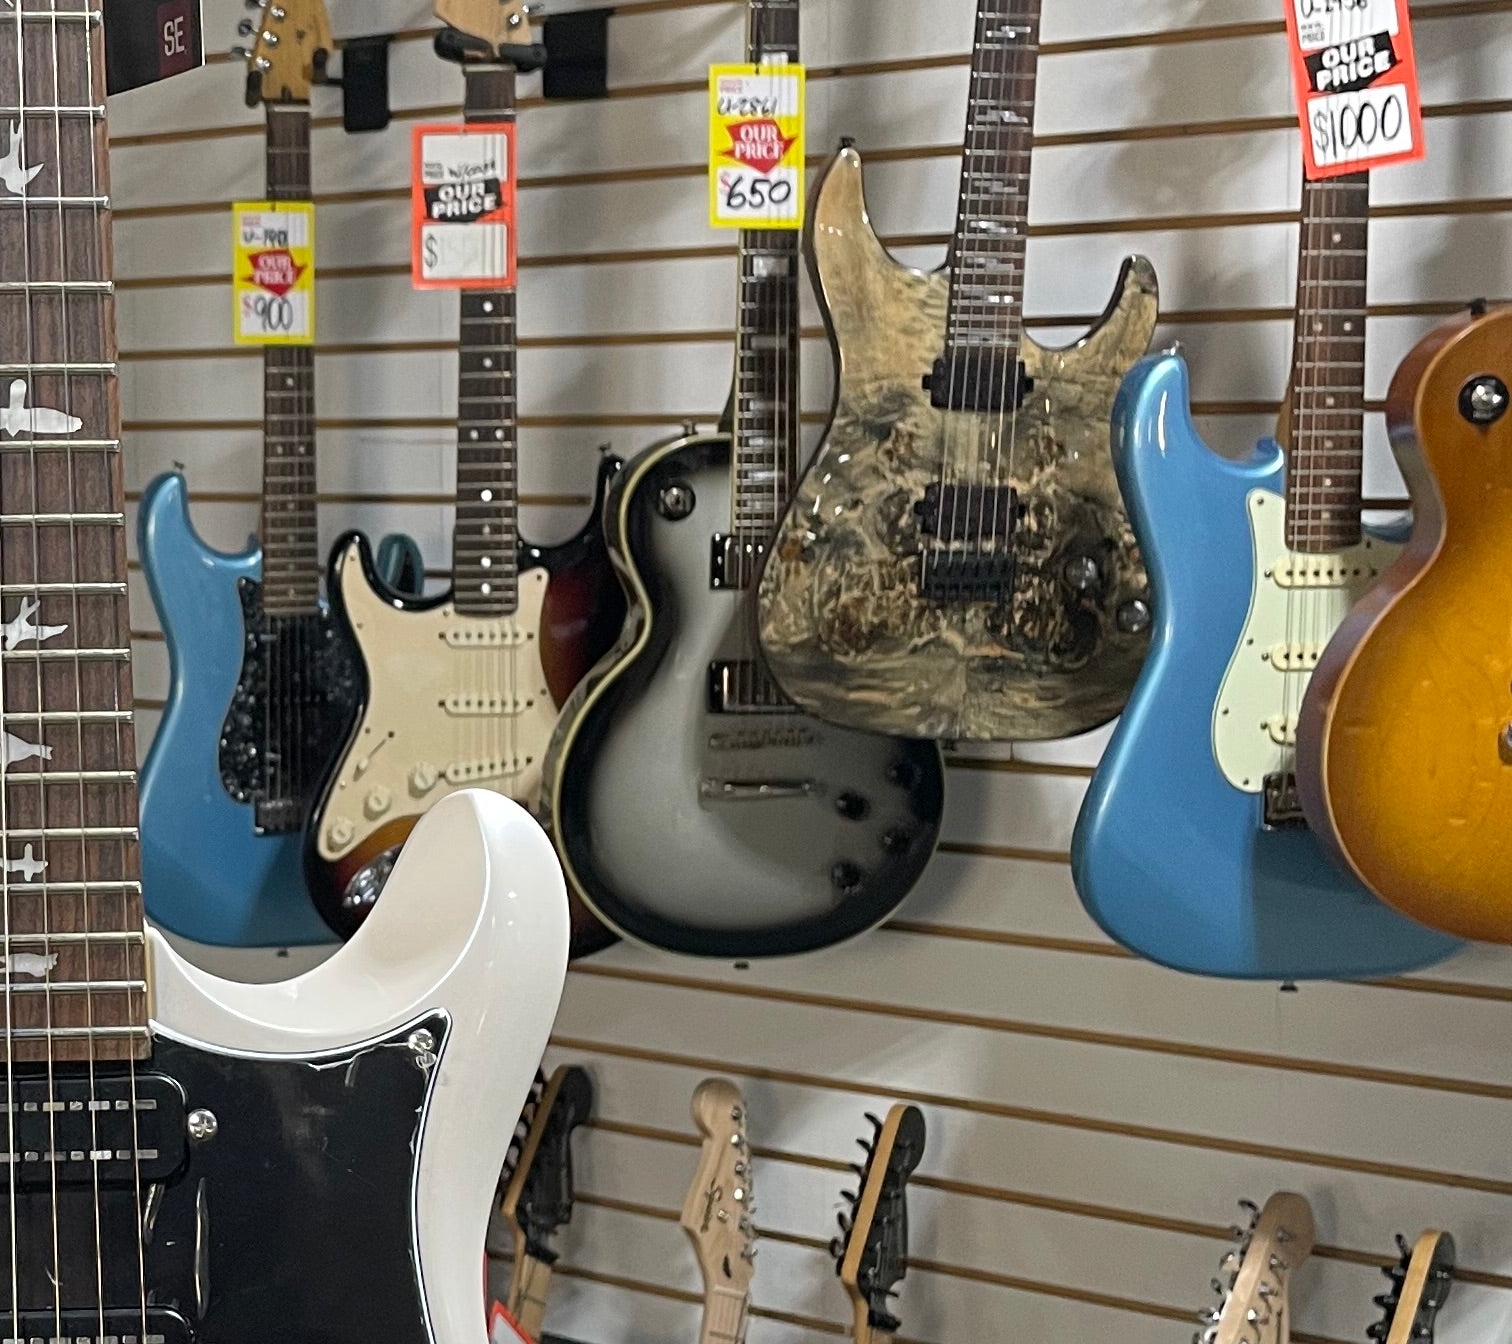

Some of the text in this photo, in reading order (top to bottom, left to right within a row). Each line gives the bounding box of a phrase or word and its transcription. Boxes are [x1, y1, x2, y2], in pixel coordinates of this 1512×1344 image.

[162, 16, 186, 57] SE
[1321, 36, 1376, 70] OUR
[1316, 49, 1392, 93] PRICE
[739, 123, 778, 143] OUR
[1313, 93, 1403, 161] $1000
[734, 140, 784, 160] PRICE
[438, 182, 487, 203] OUR
[431, 193, 498, 219] PRICE
[258, 253, 292, 272] OUR
[253, 269, 296, 286] PRICE
